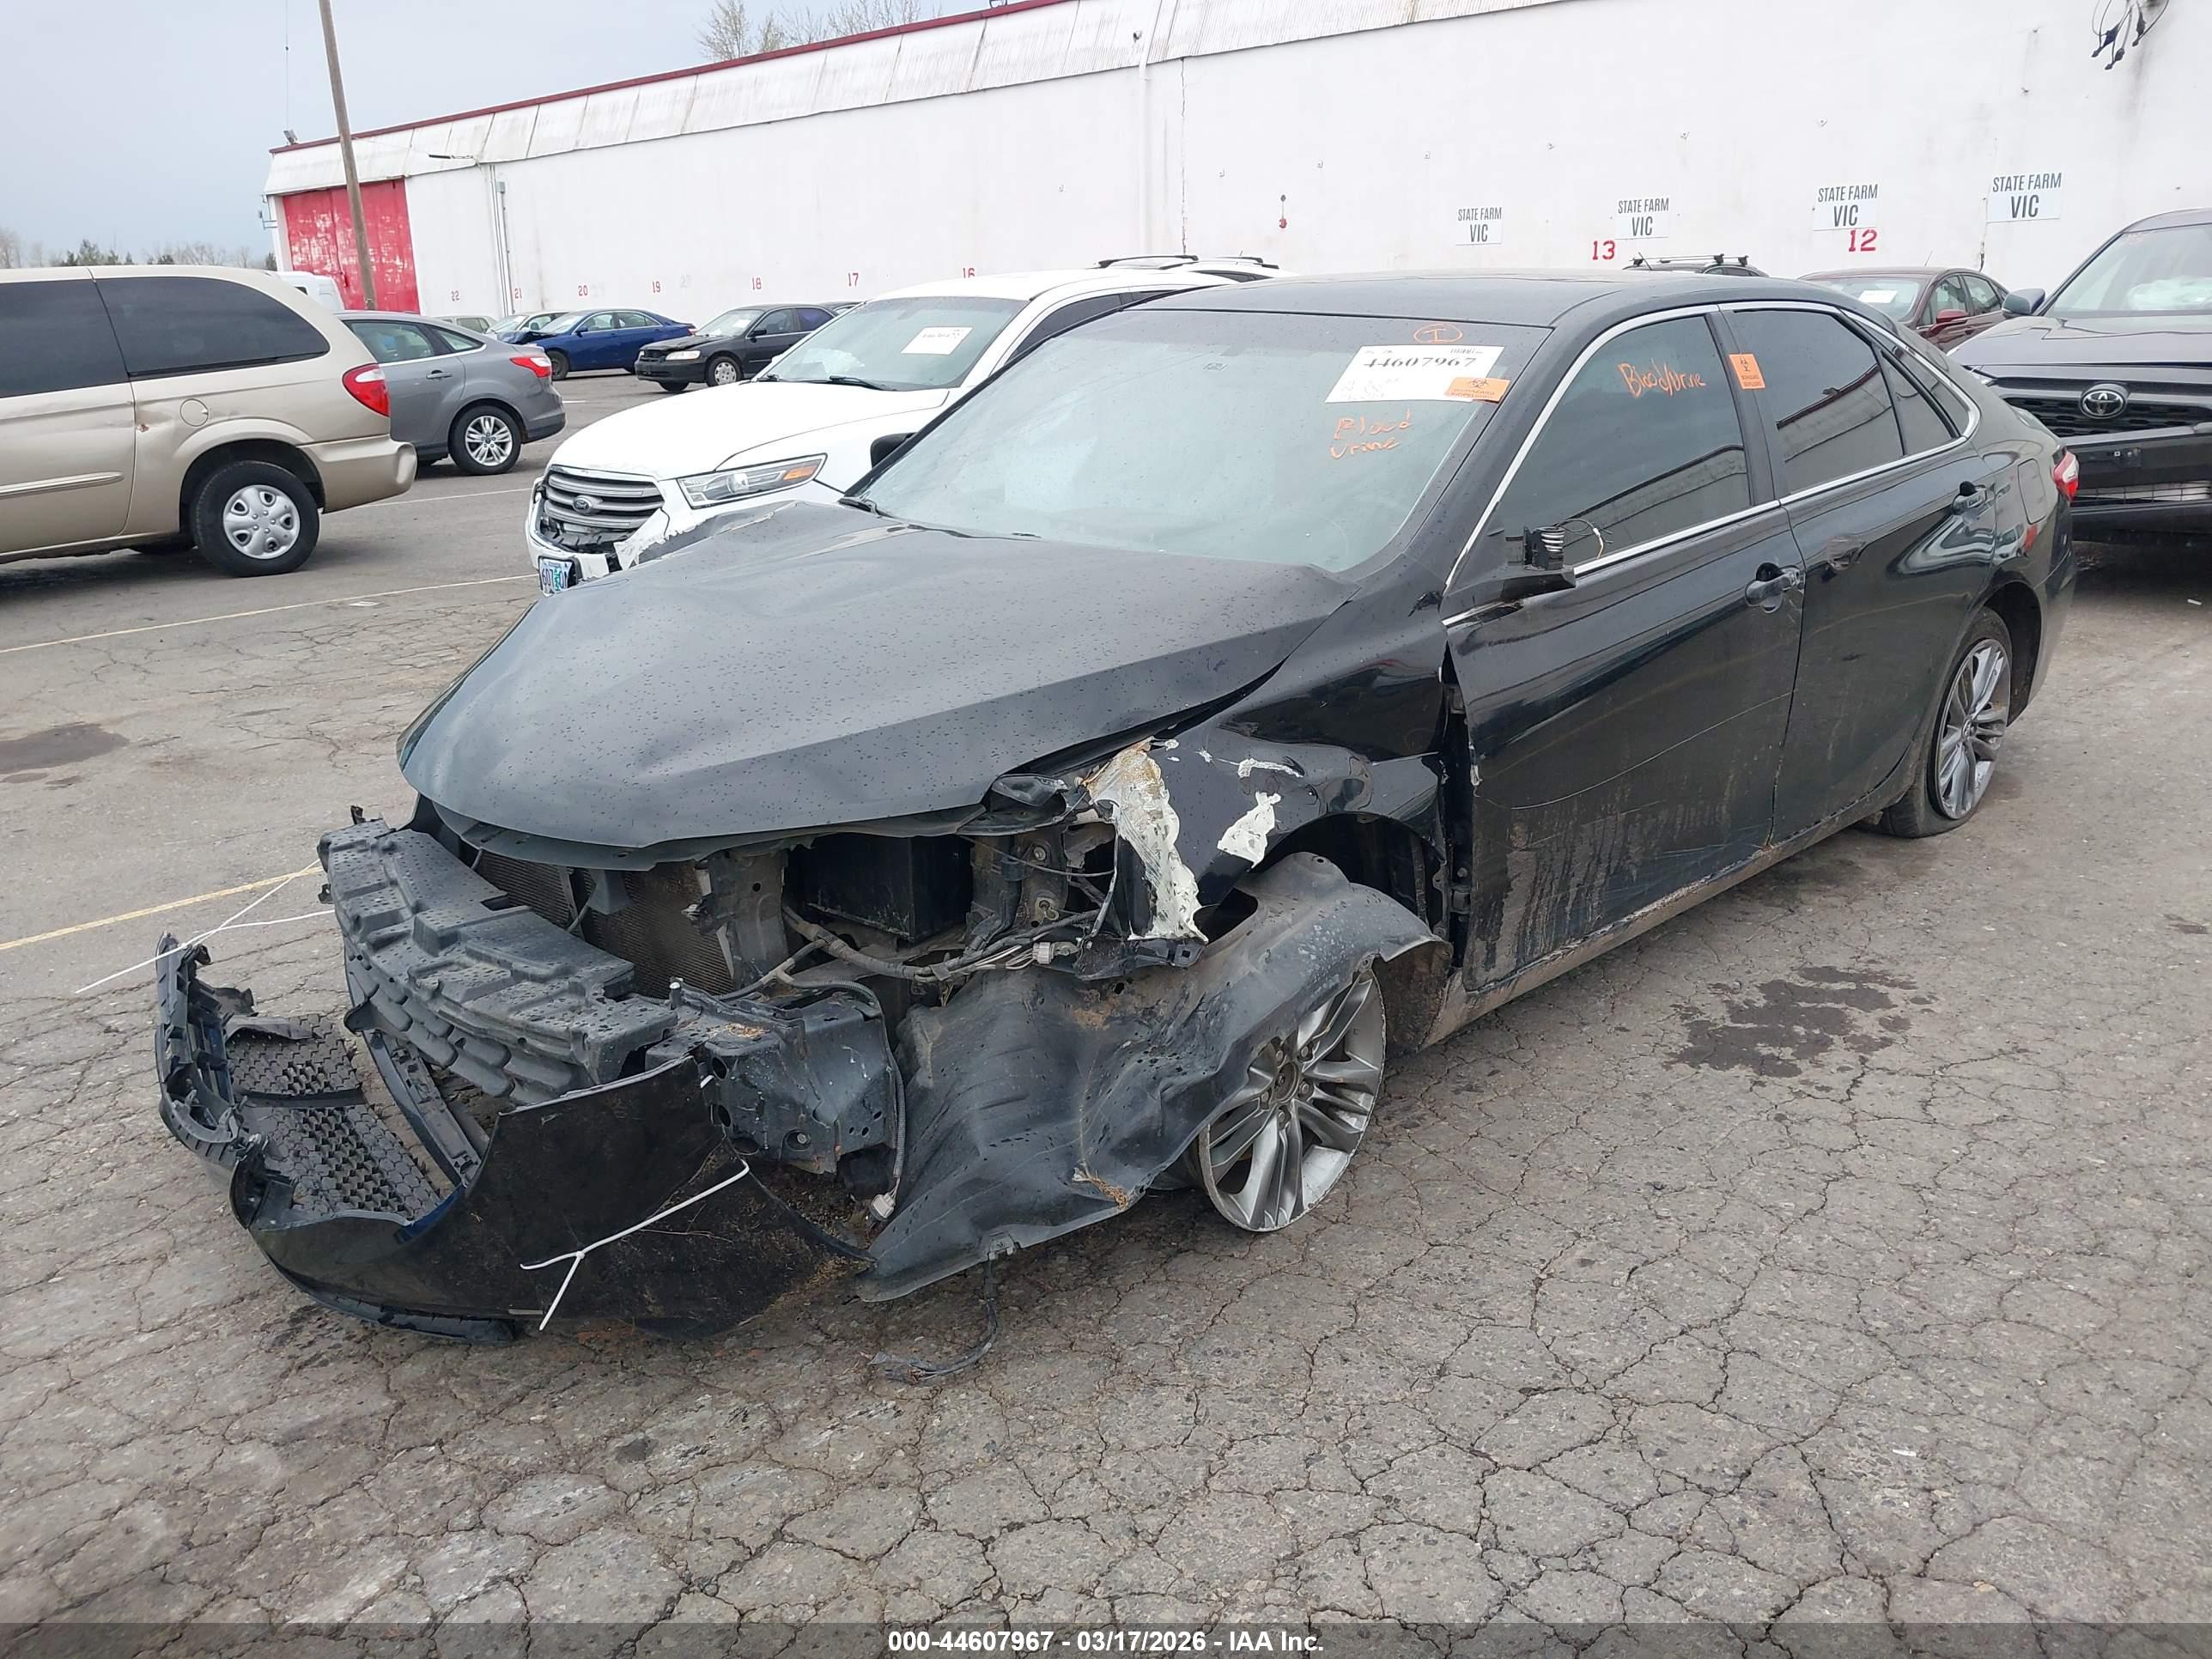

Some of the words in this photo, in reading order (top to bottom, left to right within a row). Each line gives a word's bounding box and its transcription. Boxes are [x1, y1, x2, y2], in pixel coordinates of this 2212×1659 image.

[1992, 174, 2025, 192] STATE
[2027, 172, 2062, 191] FARM
[1818, 185, 1846, 203] STATE
[1848, 184, 1878, 200] FARM
[1618, 199, 1642, 214] STATE
[1644, 198, 1669, 212] FARM
[2010, 194, 2039, 218] VIC
[1457, 208, 1479, 222] STATE
[1480, 207, 1502, 221] FARM
[1833, 204, 1858, 227] VIC
[1469, 224, 1488, 242] VIC
[1632, 216, 1653, 236] VIC
[1849, 229, 1878, 252] 12
[1592, 240, 1615, 260] 13
[653, 281, 661, 294] 19
[752, 277, 762, 290] 18
[848, 272, 859, 287] 17
[451, 290, 460, 301] 22
[514, 288, 522, 300] 21
[578, 285, 588, 297] 20
[1363, 356, 1477, 368] 44607967
